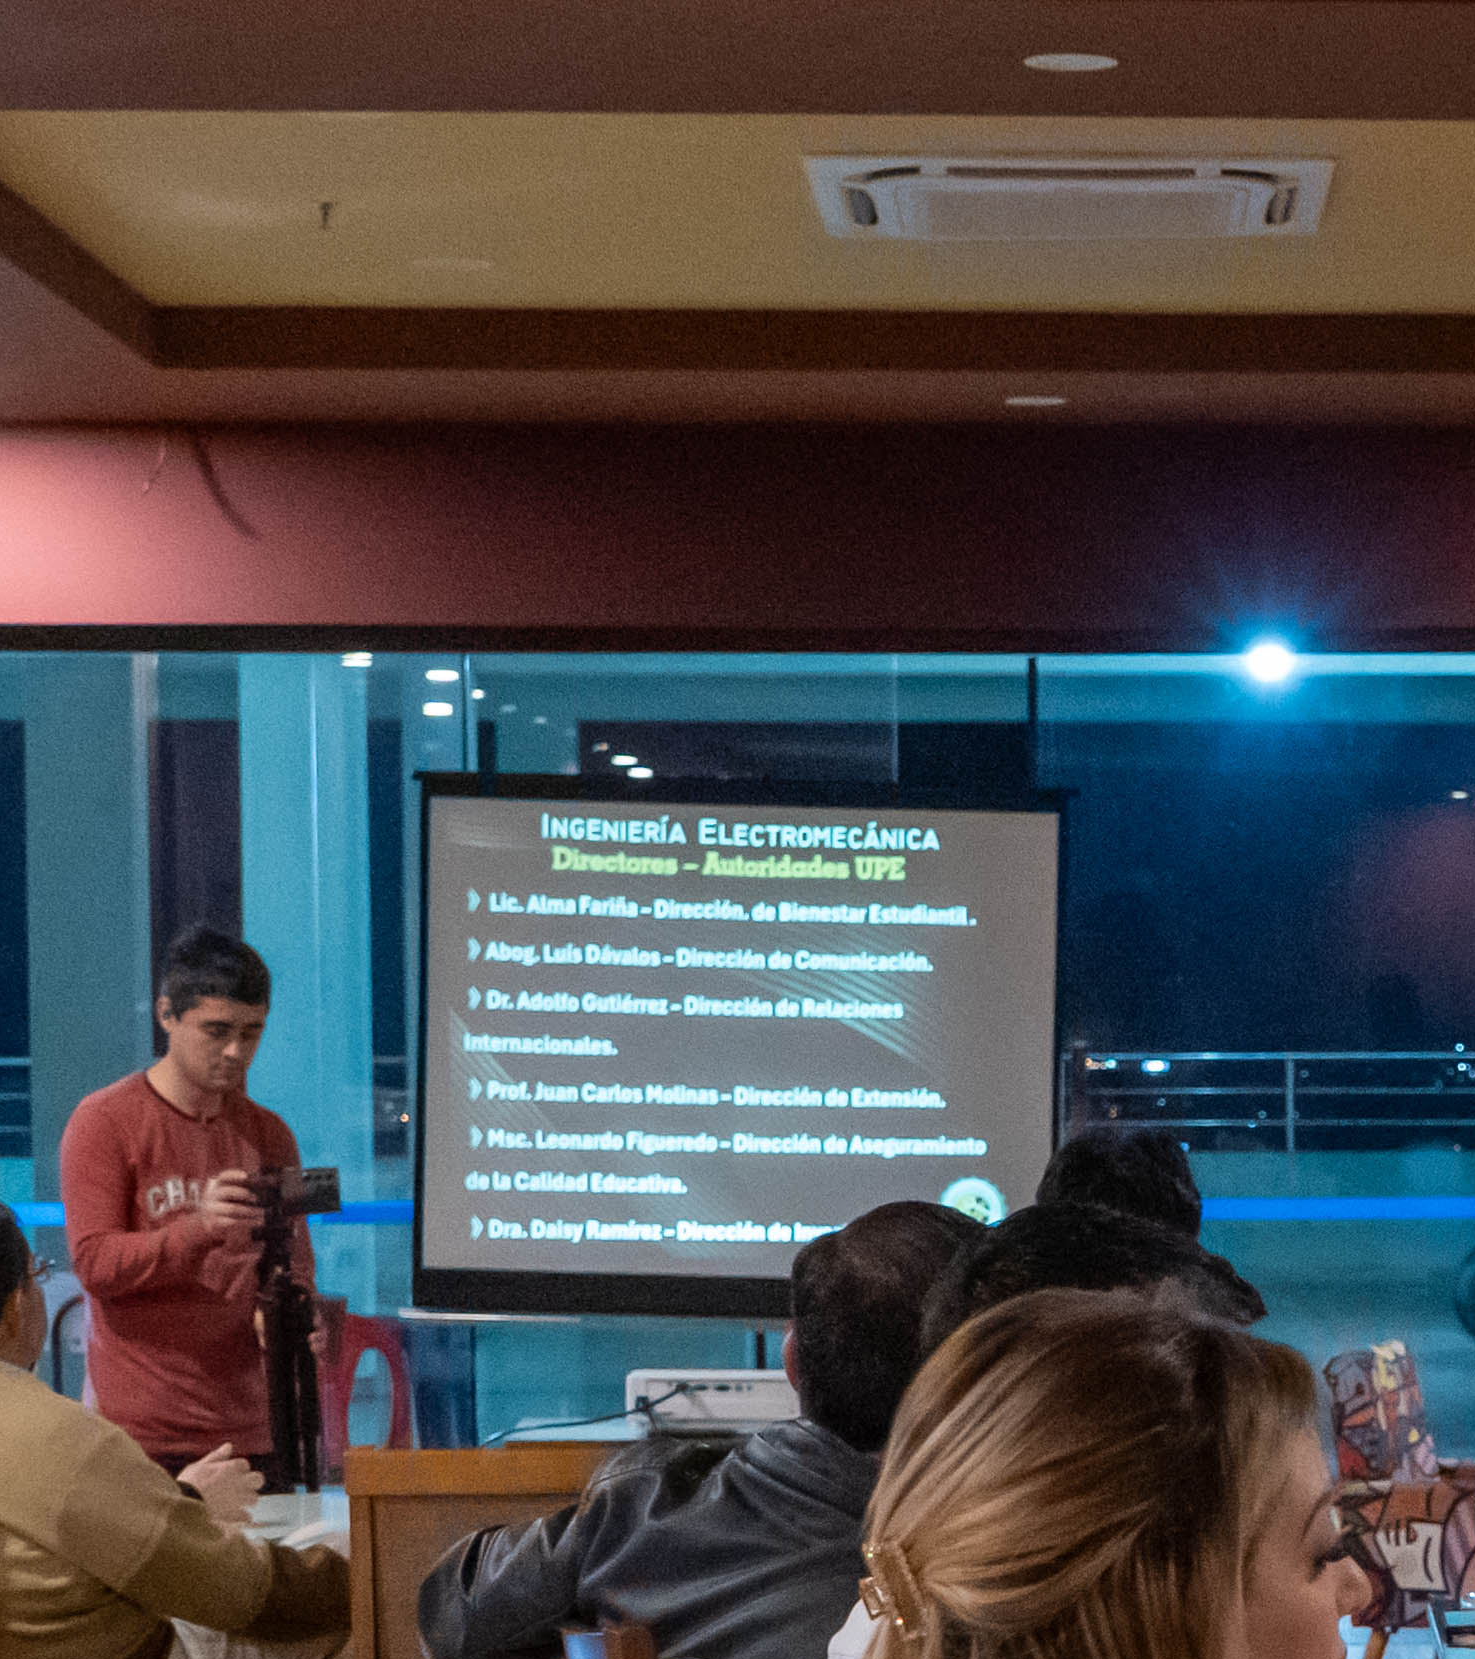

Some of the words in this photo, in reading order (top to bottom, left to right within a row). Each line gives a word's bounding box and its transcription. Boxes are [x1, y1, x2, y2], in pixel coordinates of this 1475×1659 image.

[541, 812, 687, 845] INGENIERÍA
[697, 817, 941, 851] ELECTROMECÁNICA
[551, 844, 679, 876] Directores
[701, 850, 851, 879] Autoridades
[853, 855, 907, 881] UPE
[488, 892, 525, 913] Lic.
[525, 894, 577, 915] Alma
[578, 894, 639, 918] Fariña
[750, 901, 777, 922] de
[777, 901, 868, 924] Bienestar
[584, 943, 662, 967] Dávalos
[675, 946, 767, 970] Dirección
[766, 949, 793, 970] de
[793, 949, 935, 973] Comunicación.
[485, 989, 515, 1010] Dr.
[515, 990, 580, 1013] Adolfo
[580, 991, 669, 1016] Gutiérrez
[683, 994, 774, 1018] Dirección
[774, 994, 801, 1018] de
[800, 997, 905, 1020] Relaciones
[462, 1031, 619, 1056] Internacionales.
[485, 1079, 534, 1102] Prof.
[533, 1081, 579, 1103] Juan
[580, 1082, 644, 1104] Carlos
[644, 1083, 720, 1106] Molinas
[732, 1085, 824, 1107] Dirección
[823, 1087, 850, 1108] de
[850, 1087, 947, 1109] Extensión.
[486, 1127, 534, 1149] Msc.
[534, 1129, 625, 1151] Leonardo
[731, 1132, 823, 1154] Dirección
[822, 1133, 849, 1155] de
[848, 1134, 988, 1159] Aseguramiento
[464, 1170, 491, 1191] de
[491, 1170, 512, 1191] la
[512, 1170, 589, 1193] Calidad
[589, 1172, 689, 1195] Educativa.
[487, 1218, 529, 1239] Dra.
[529, 1218, 585, 1244] Daisy
[584, 1218, 664, 1242] Ramírez
[675, 1219, 767, 1242] Dirección
[766, 1221, 793, 1243] de
